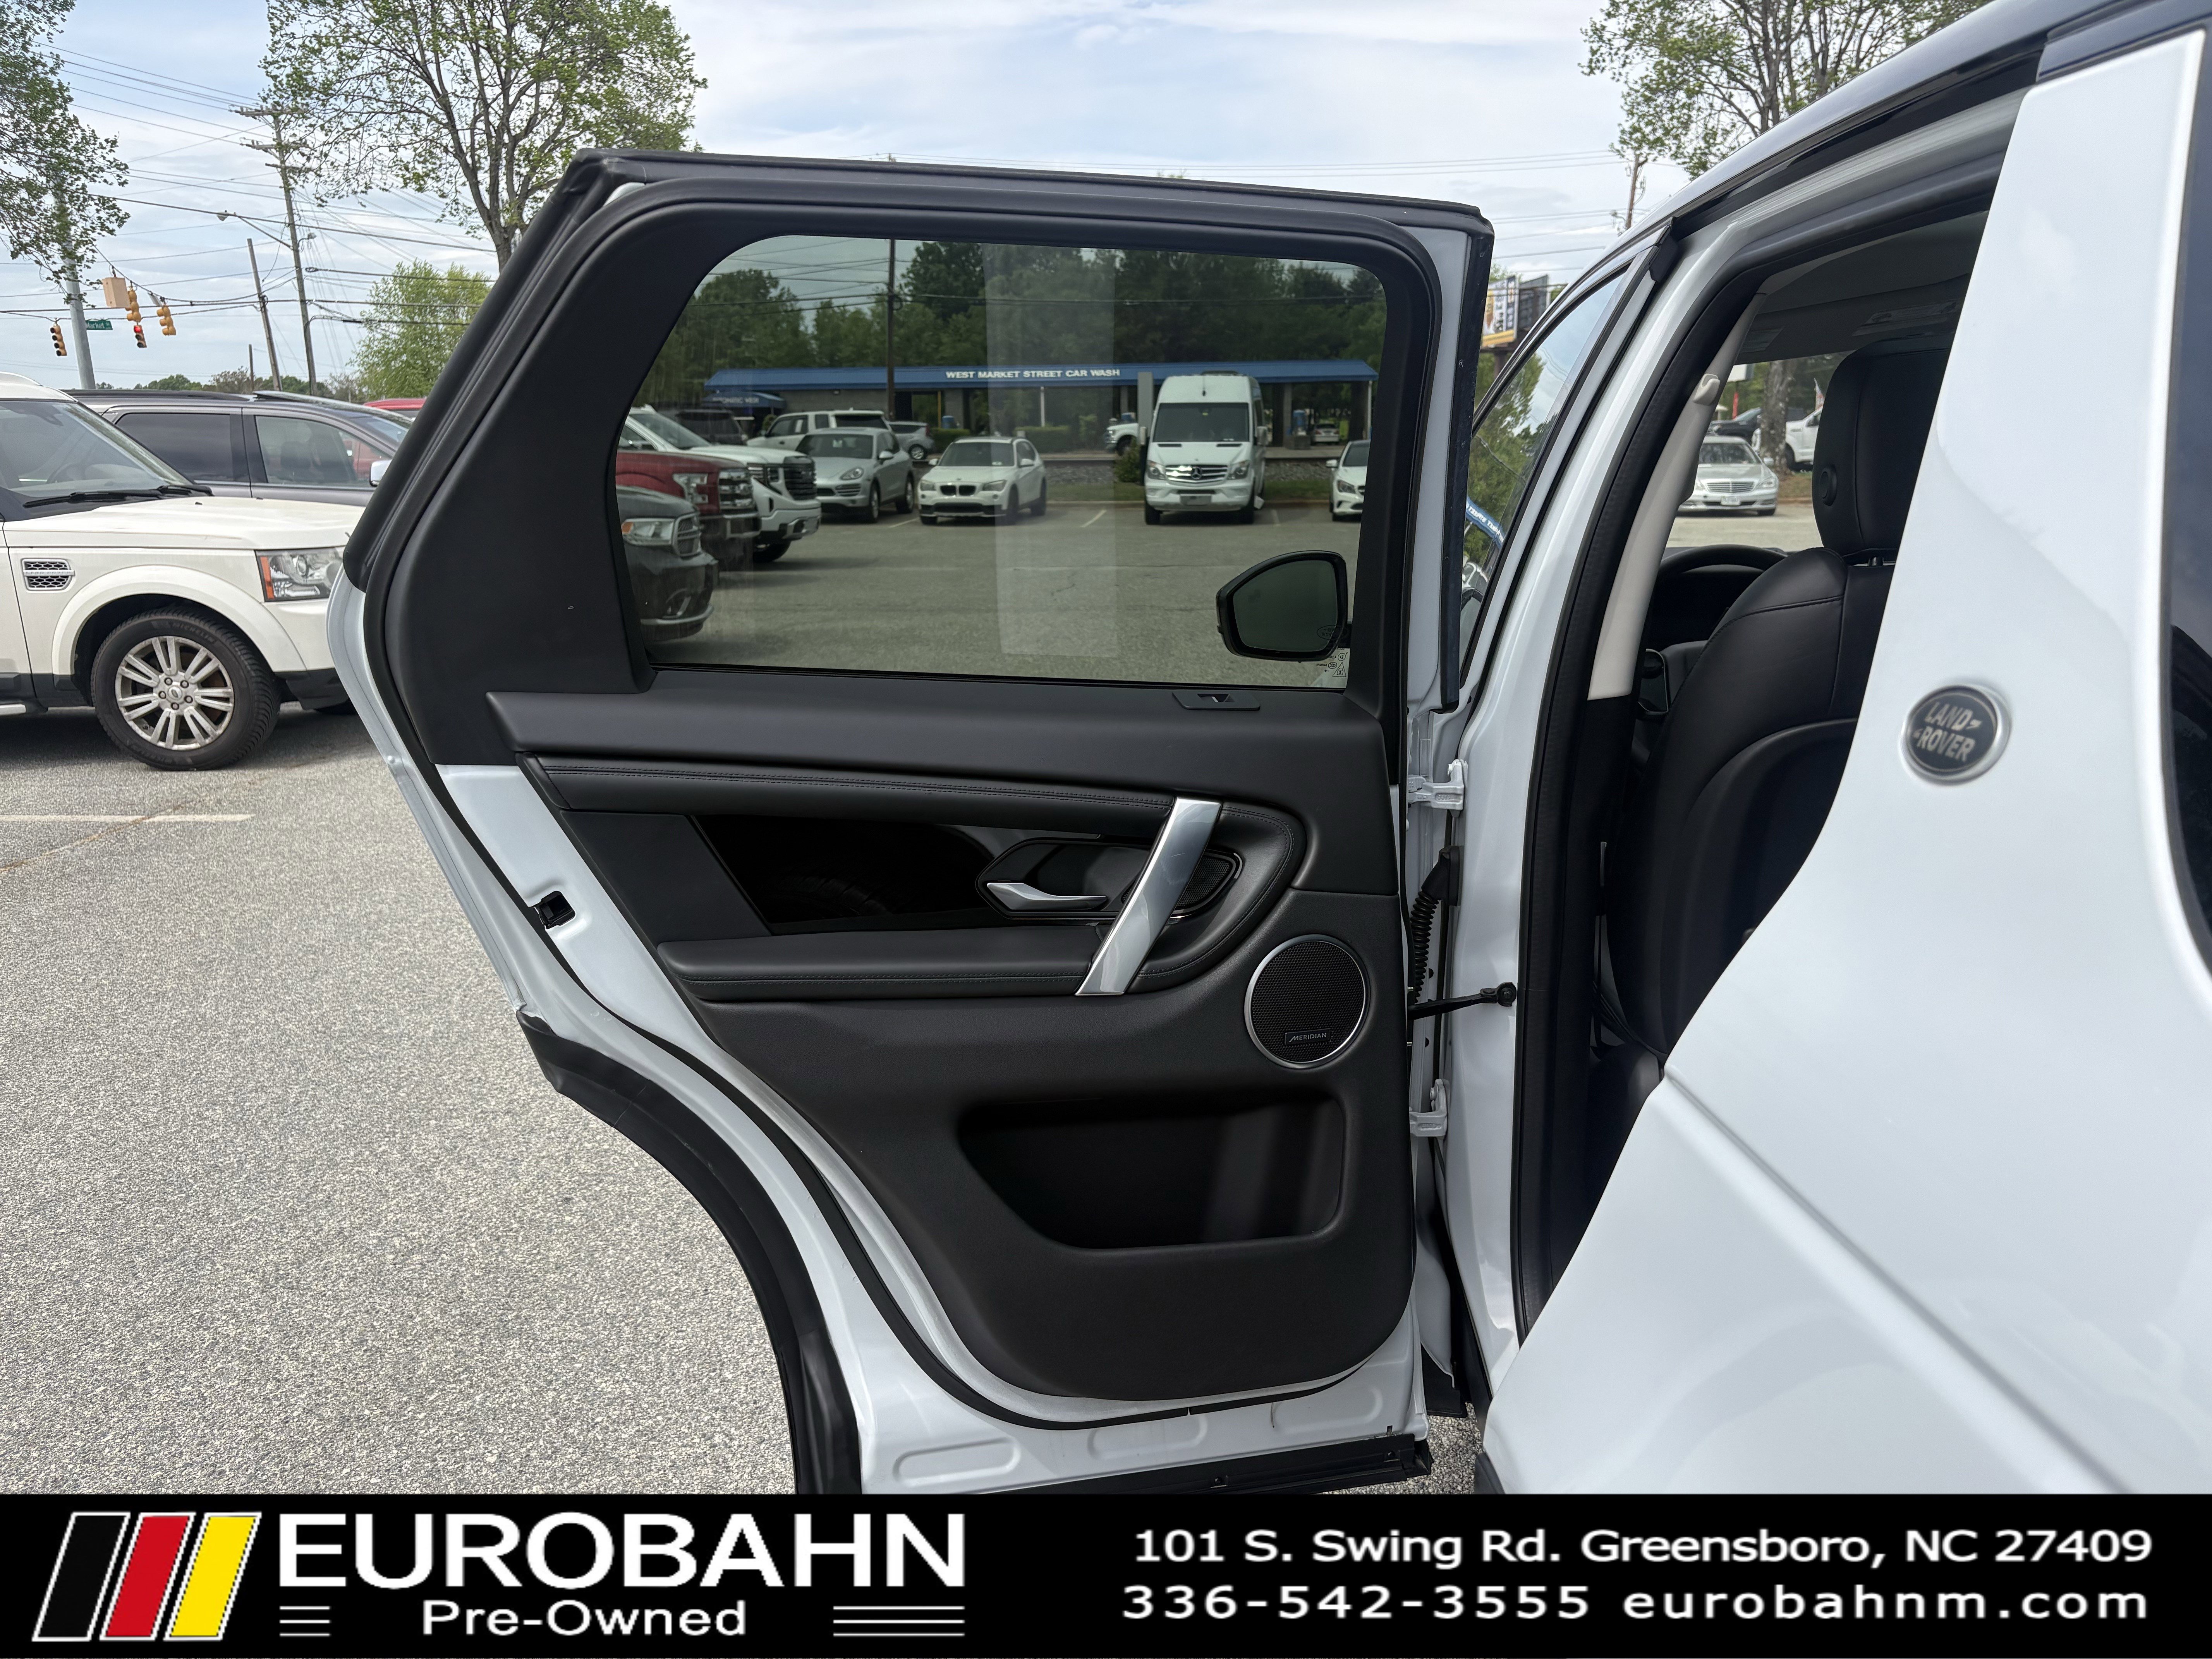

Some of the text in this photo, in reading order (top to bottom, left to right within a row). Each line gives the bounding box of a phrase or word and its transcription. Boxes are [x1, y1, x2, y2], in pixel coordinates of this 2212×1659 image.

[1924, 701, 1973, 731] LAND
[1917, 726, 1975, 763] ROVER
[1289, 1032, 1327, 1042] MERIDIAN
